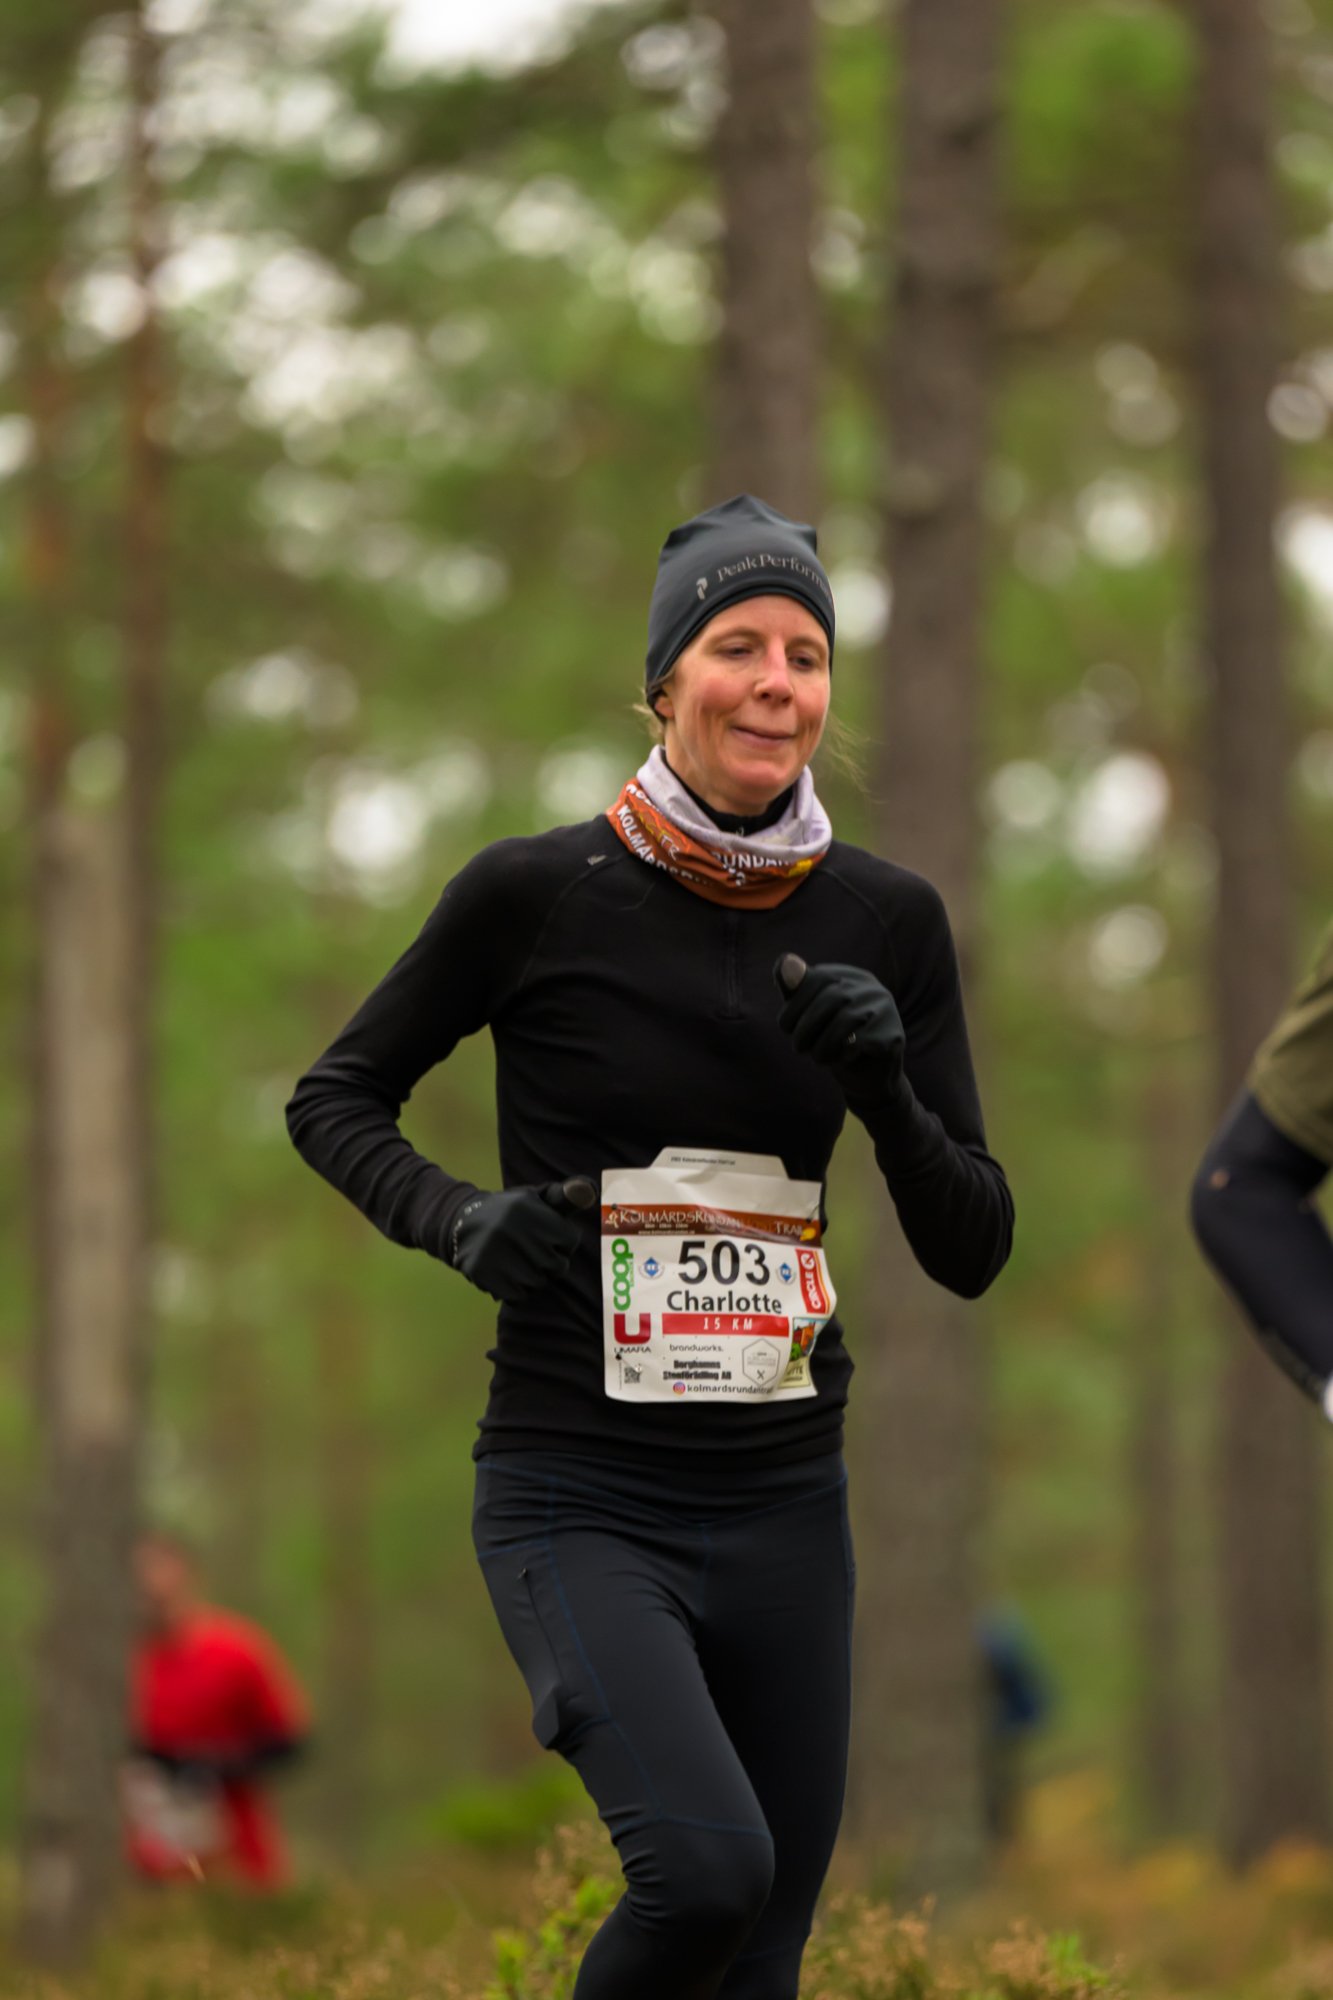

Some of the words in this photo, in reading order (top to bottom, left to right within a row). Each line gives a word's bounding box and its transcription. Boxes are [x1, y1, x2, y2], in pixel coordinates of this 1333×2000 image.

[611, 1238, 634, 1311] coop
[678, 1240, 770, 1286] 503
[666, 1290, 782, 1314] Charlotte
[732, 1317, 753, 1330] KM
